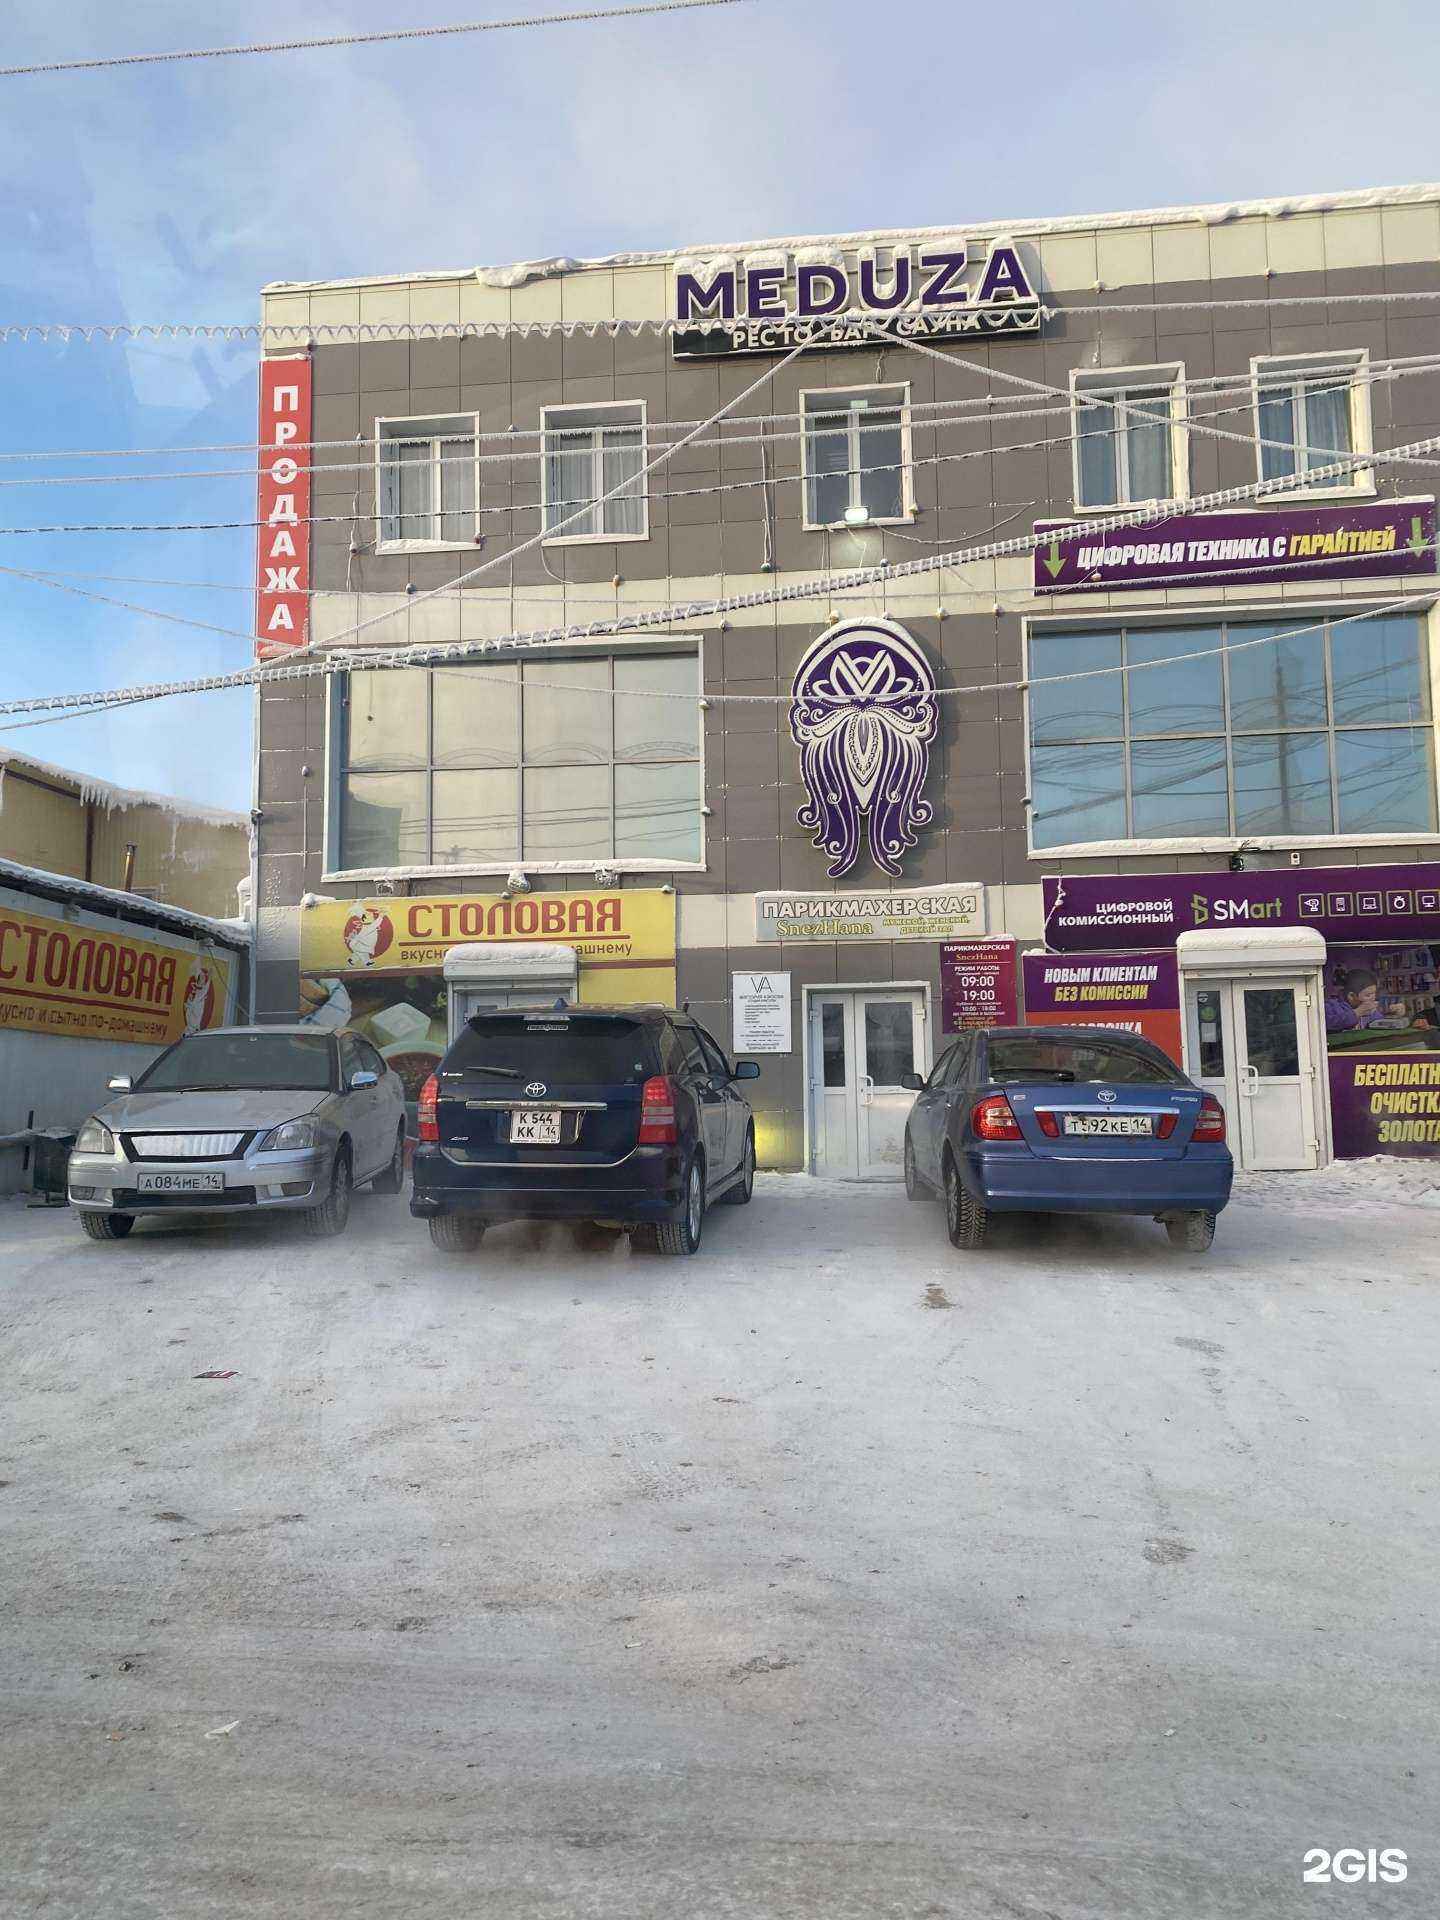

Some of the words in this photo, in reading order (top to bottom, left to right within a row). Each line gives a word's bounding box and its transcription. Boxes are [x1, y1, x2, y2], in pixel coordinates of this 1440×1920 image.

[675, 247, 1034, 321] MEDUZA
[896, 312, 982, 336] САУНА
[264, 385, 301, 631] ПРОДАЖА
[1077, 542, 1186, 569] ЦИФРОВАЯ
[1187, 537, 1271, 564] ТЕХНИКА
[1271, 536, 1288, 558] С
[762, 896, 977, 919] ПАРИКМАХЕРСКАЯ
[1096, 898, 1173, 915] ЦИФРОВОЙ
[1213, 898, 1283, 921] SMart
[408, 898, 622, 938] СТОЛОВАЯ
[1058, 910, 1174, 927] КОМИССИОННЫЙ
[776, 919, 874, 936] SnezHana
[944, 944, 1010, 952] ПАРИКМАХЕРСКАЯ
[0, 920, 176, 1005] СТОЛОВАЯ
[961, 975, 995, 987] 09:00
[1044, 967, 1091, 983] НОВЫМ
[1092, 965, 1158, 982] КЛИЕНТАМ
[963, 989, 996, 1001] 19:00
[1054, 985, 1079, 1002] БЕЗ
[1080, 984, 1149, 1001] КОМИССИИ
[532, 1113, 553, 1125] 544
